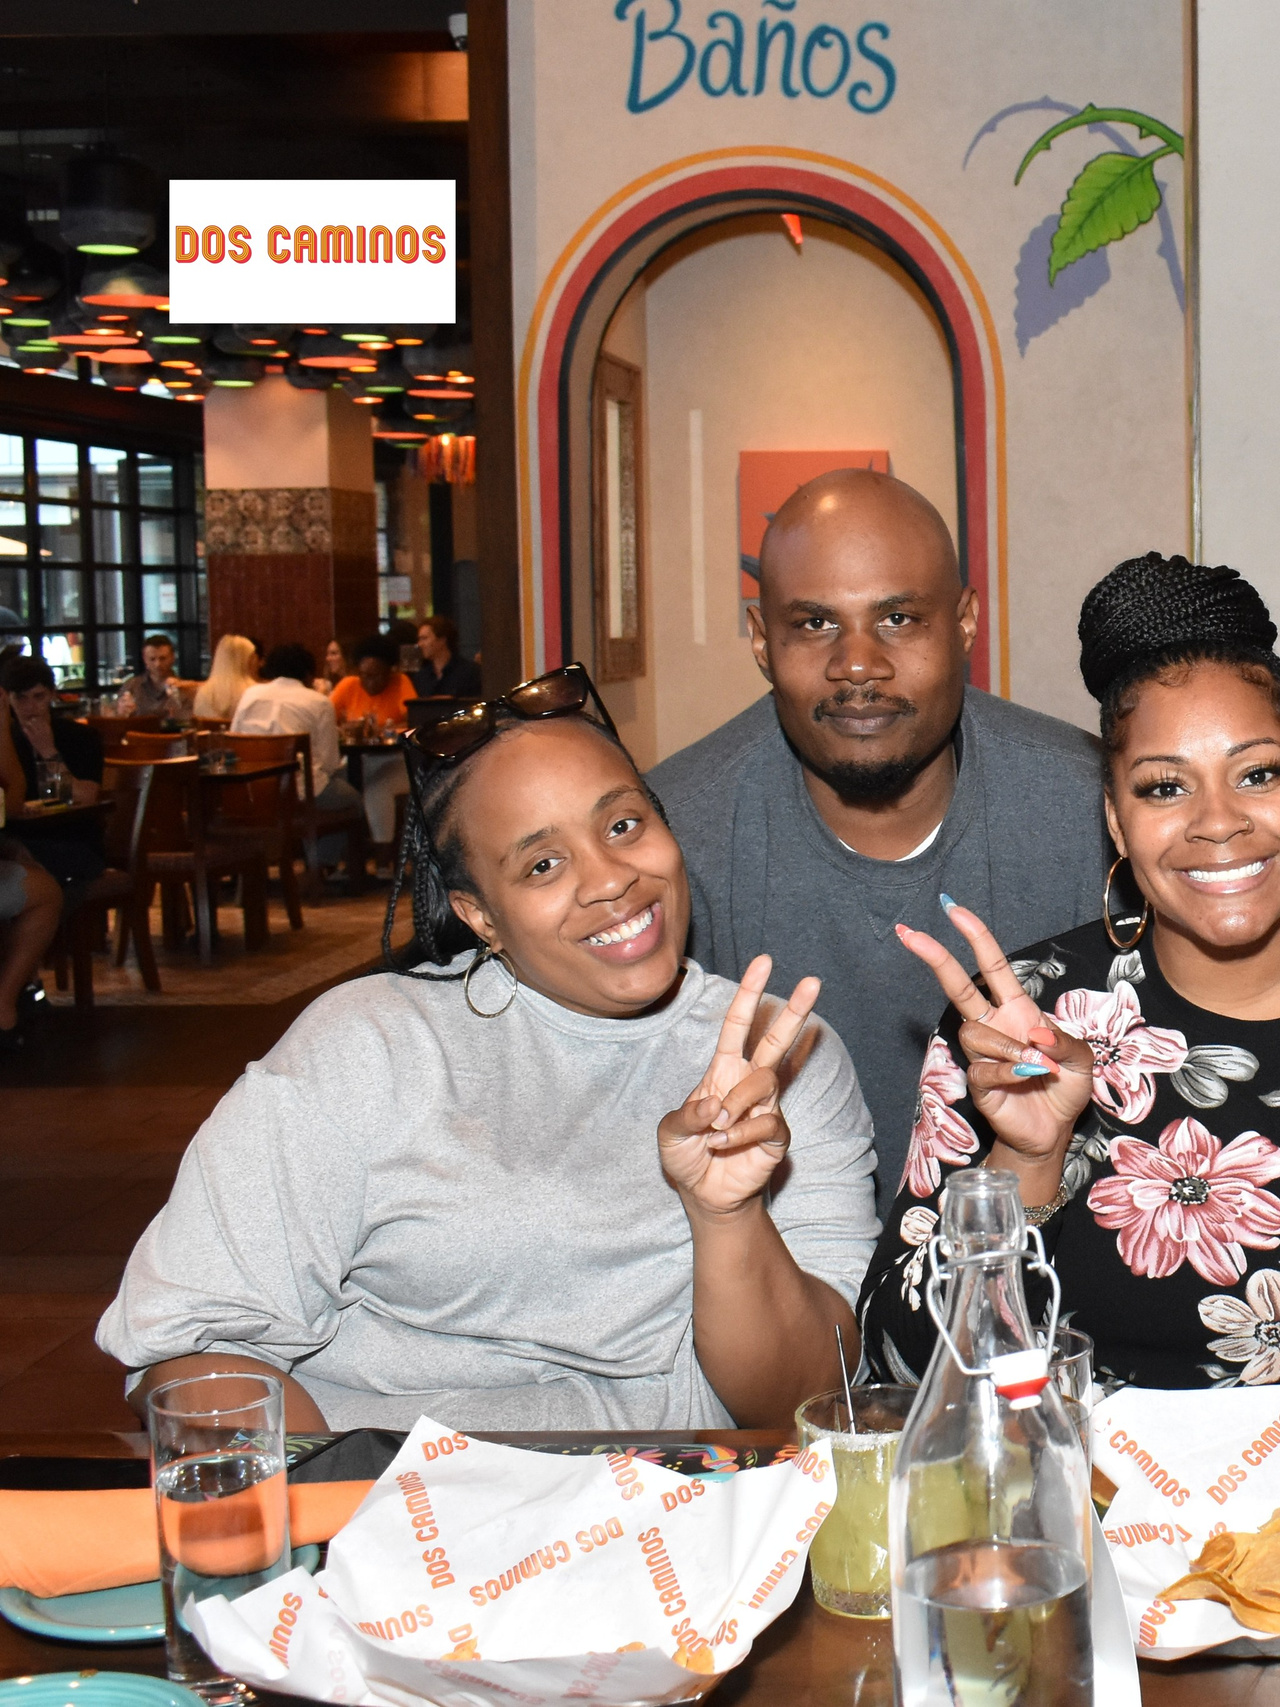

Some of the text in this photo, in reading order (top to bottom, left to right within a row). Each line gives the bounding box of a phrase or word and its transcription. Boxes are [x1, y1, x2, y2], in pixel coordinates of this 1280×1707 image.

[613, 0, 897, 115] Baños
[421, 1432, 469, 1461] DOS
[1109, 1429, 1191, 1507] CAMINOS
[660, 1478, 706, 1513] DOS
[1206, 1464, 1248, 1506] DOS
[422, 1547, 456, 1590] DOS
[469, 1516, 625, 1607] DOS CAMINOS
[637, 1526, 687, 1617] CAMINOS
[355, 1603, 434, 1641] MINOS
